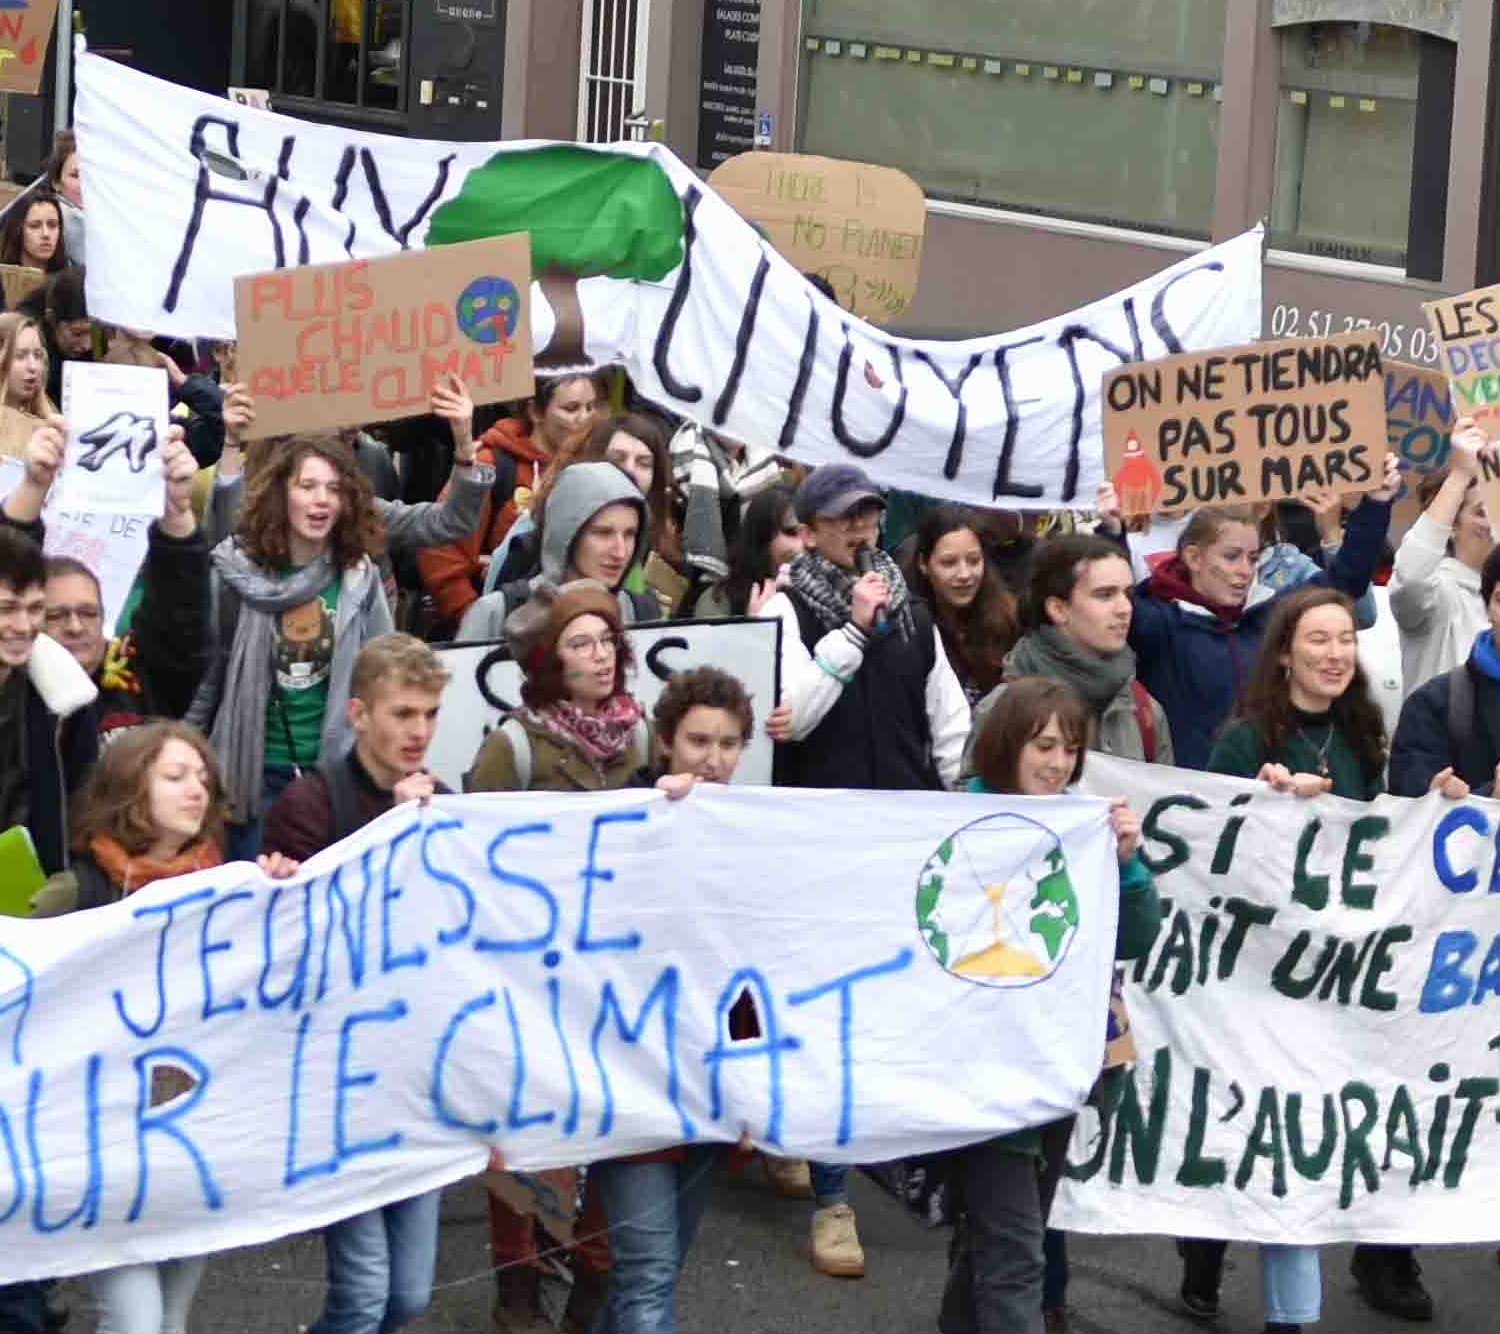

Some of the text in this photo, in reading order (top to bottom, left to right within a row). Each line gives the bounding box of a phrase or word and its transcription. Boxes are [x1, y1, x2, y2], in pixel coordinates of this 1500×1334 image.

[251, 260, 376, 323] PLUS
[1434, 298, 1500, 342] LES
[296, 301, 454, 369] CHAUD
[369, 342, 514, 412] CLIMAT
[1107, 341, 1385, 414] ON NE TIENDRA
[1158, 399, 1353, 462] PAS TOUS
[1161, 444, 1372, 507] SUR MARS
[1291, 814, 1391, 910] LE
[112, 809, 649, 1039] JEUNESSE
[1270, 923, 1415, 1013] UNE
[283, 998, 408, 1187] LE
